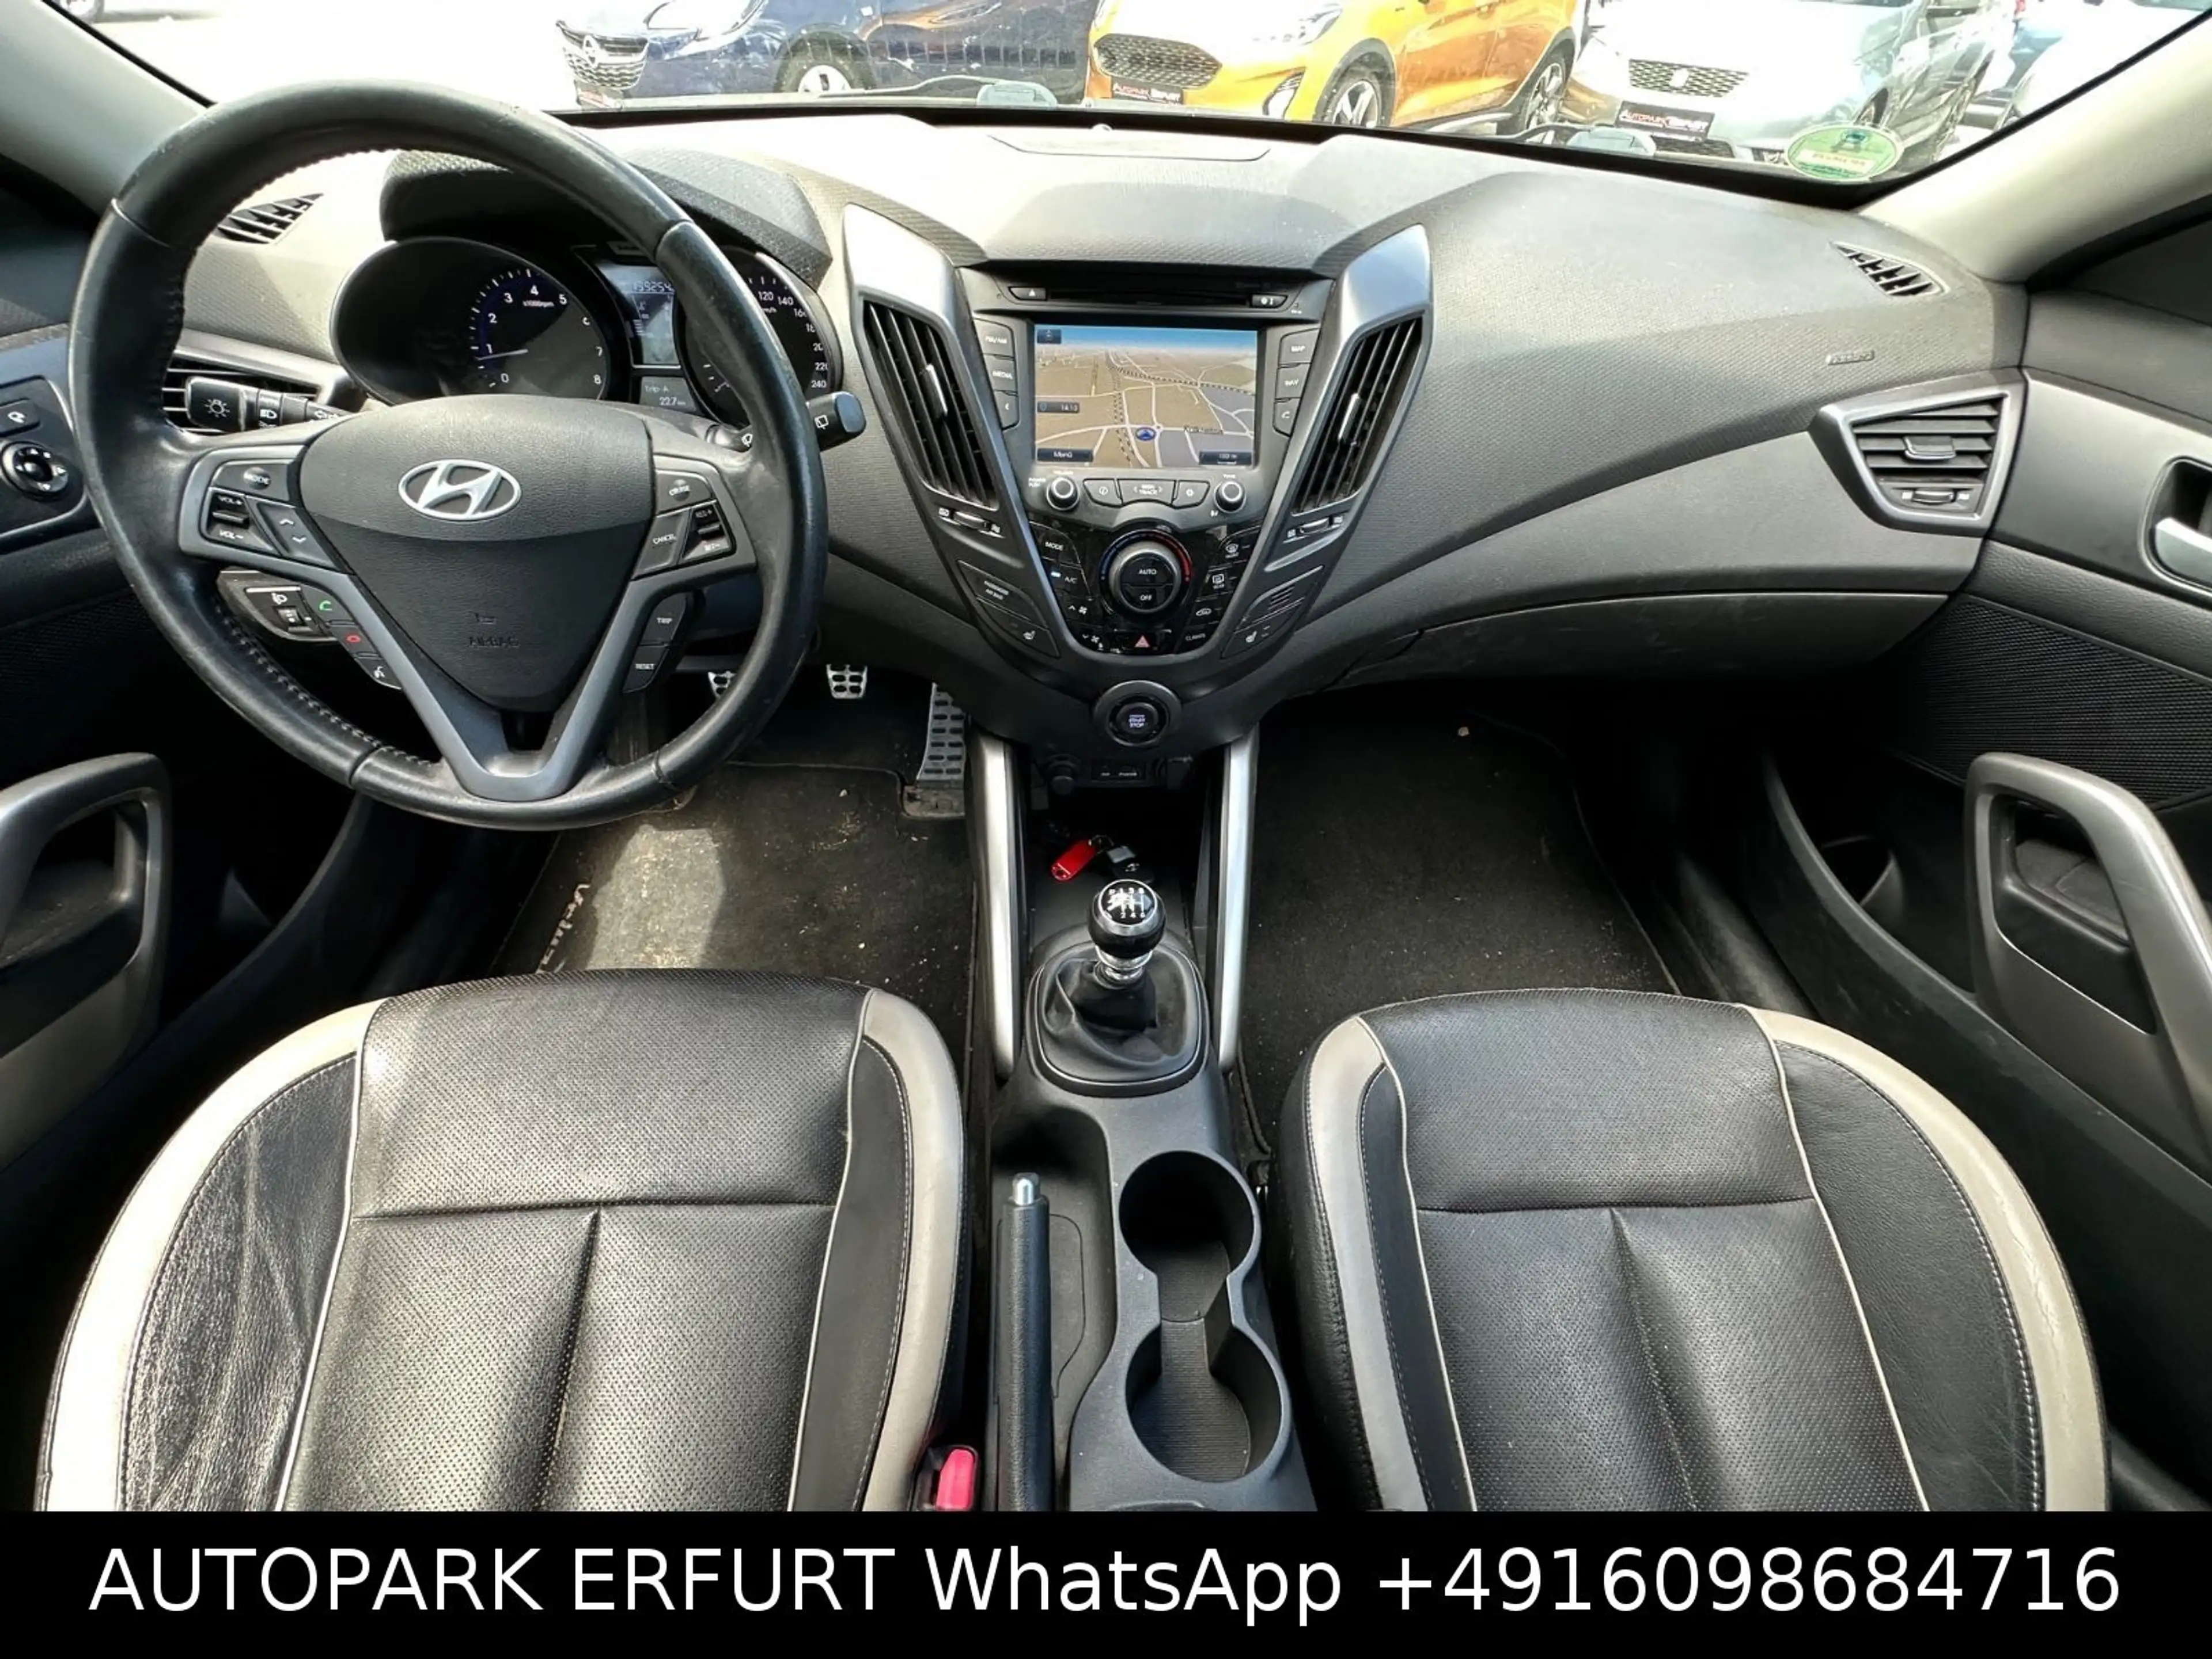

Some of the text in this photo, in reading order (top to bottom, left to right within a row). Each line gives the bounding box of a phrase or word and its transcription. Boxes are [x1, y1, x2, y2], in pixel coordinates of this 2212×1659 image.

[531, 285, 539, 296] 4
[505, 293, 513, 304] 3
[559, 294, 567, 305] 5
[759, 291, 774, 301] 120
[778, 296, 794, 305] 140
[488, 313, 497, 324] 2
[487, 344, 492, 354] 1
[596, 346, 603, 357] 7
[501, 373, 509, 383] 0
[593, 375, 601, 385] 8
[811, 380, 827, 388] 240
[1045, 541, 1064, 551] MODE
[1065, 576, 1078, 584] A/C
